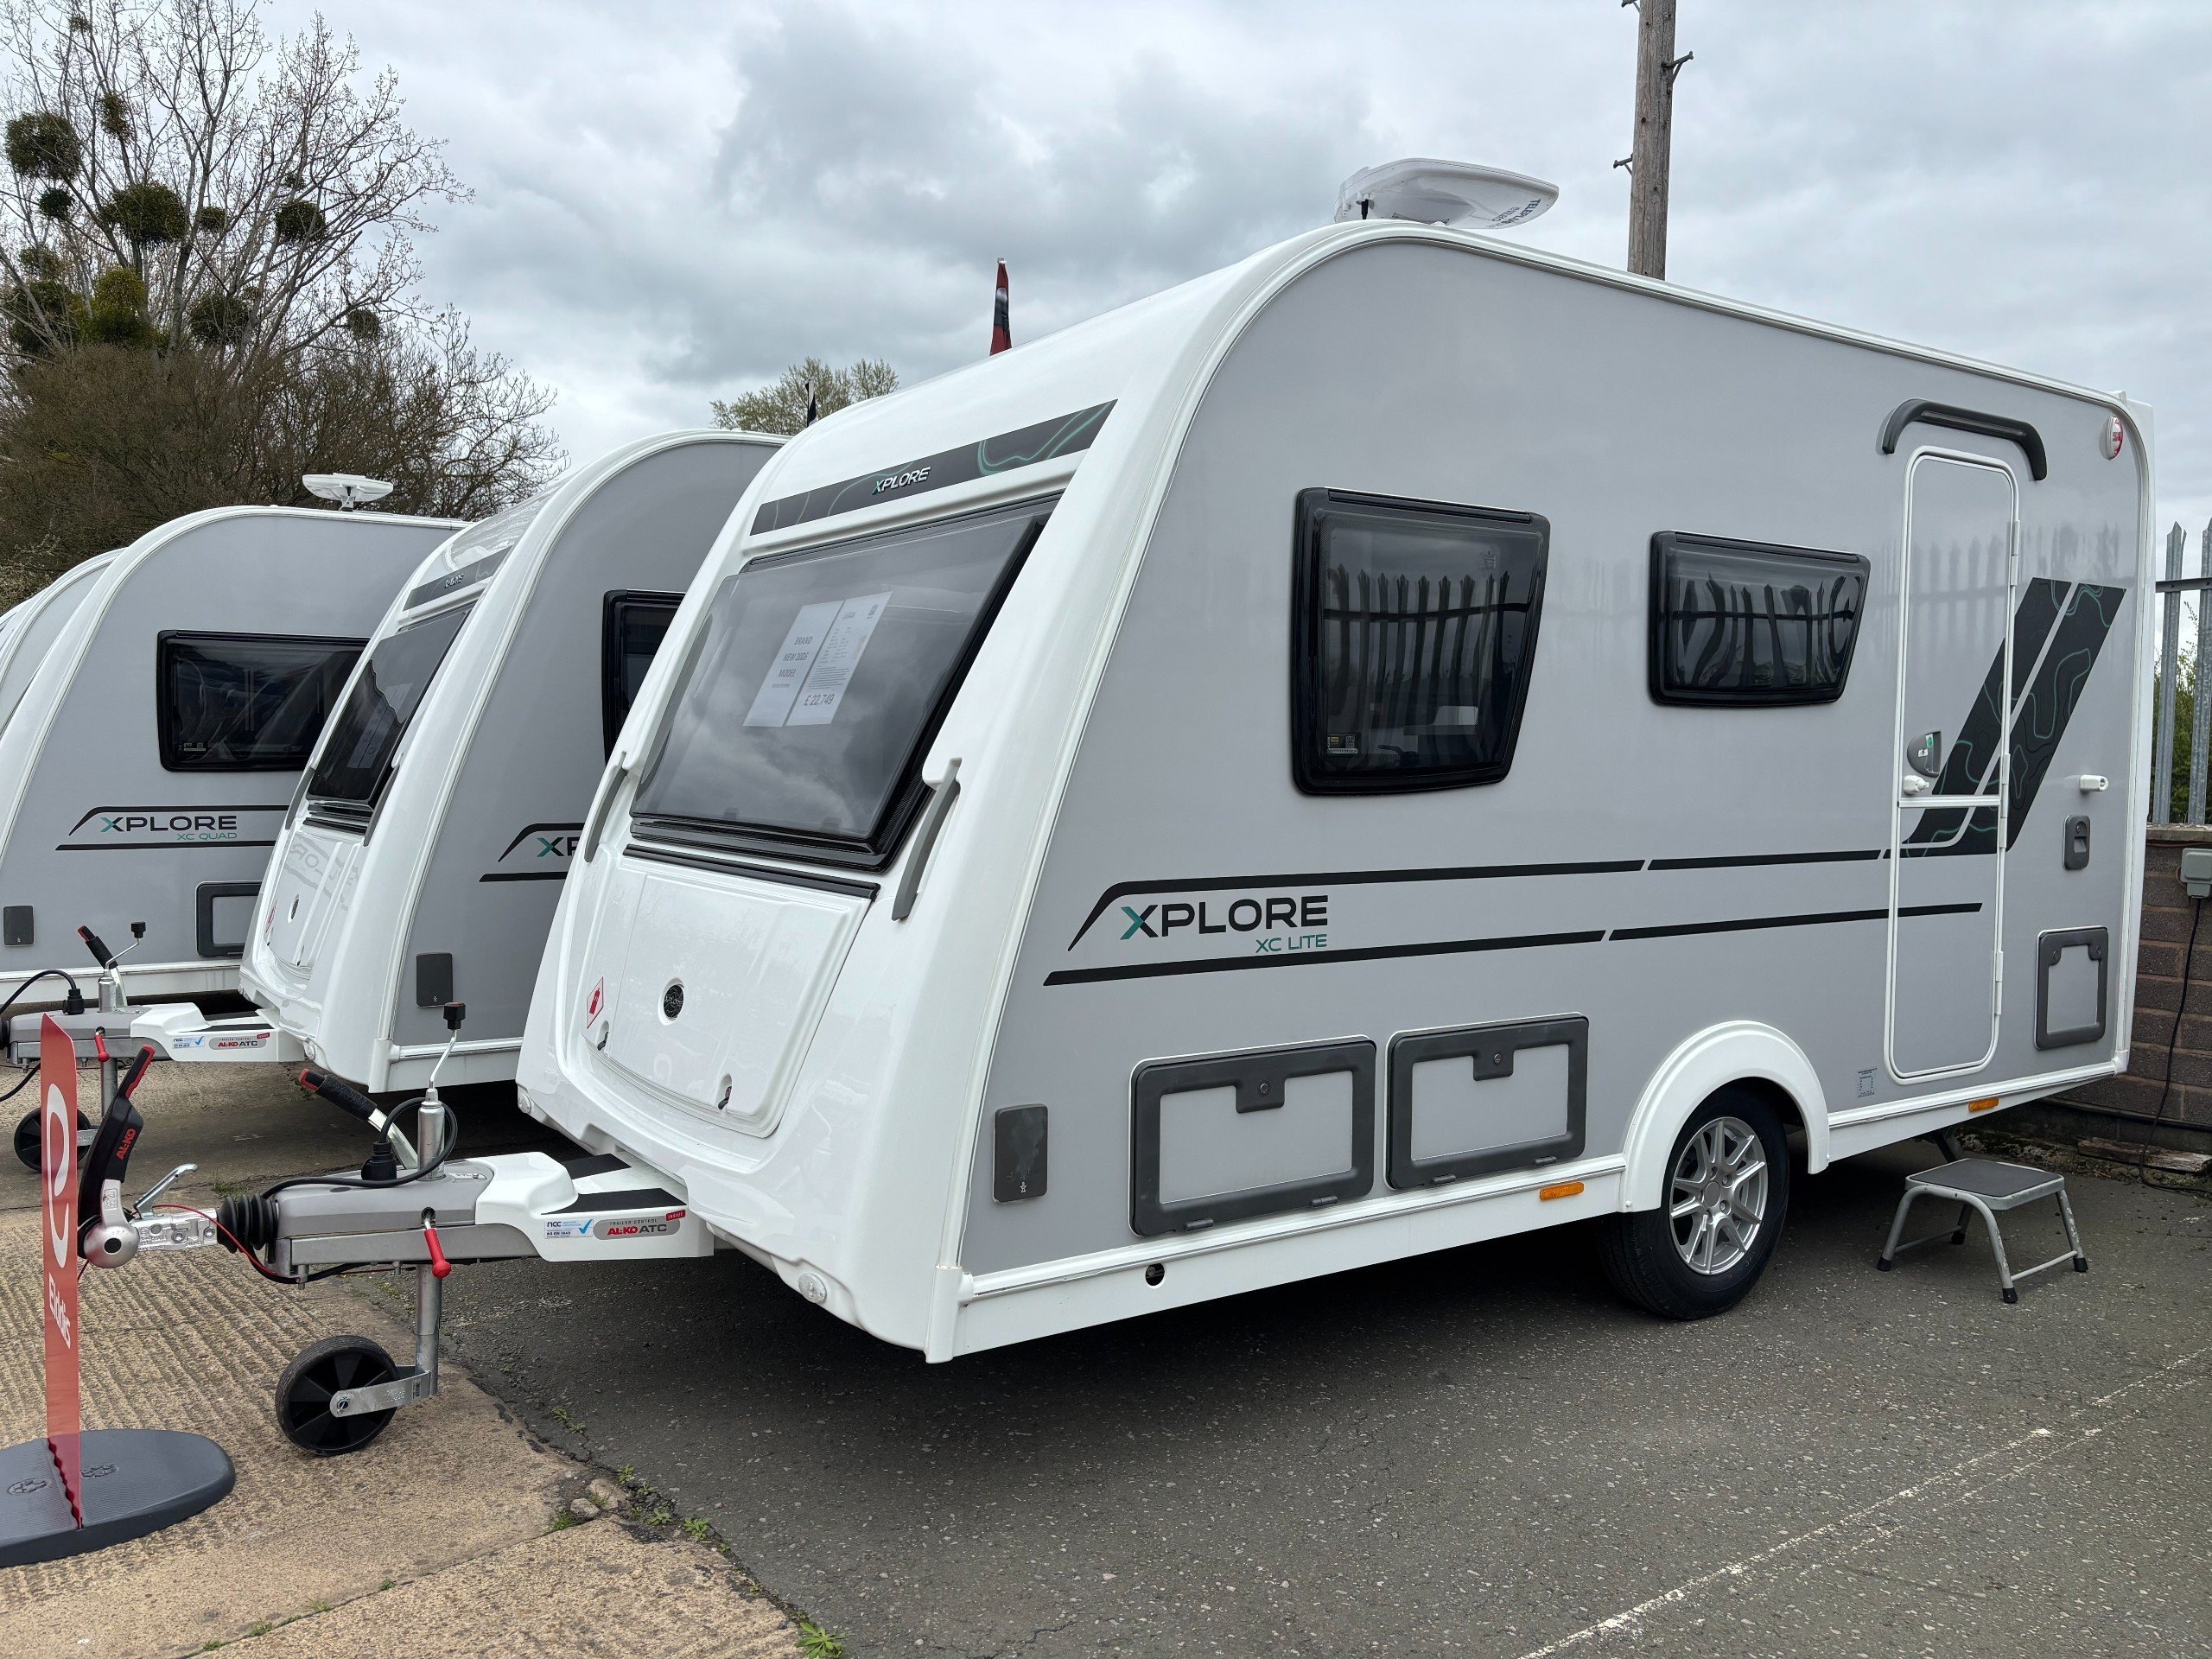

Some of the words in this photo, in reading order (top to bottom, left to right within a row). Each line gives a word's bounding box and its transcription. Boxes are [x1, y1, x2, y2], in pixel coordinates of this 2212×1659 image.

[872, 467, 931, 495] XPLORE
[794, 636, 813, 645] BRAND
[778, 669, 796, 677] MODEL
[100, 815, 238, 833] XPLORE
[199, 832, 238, 841] QUAD
[1120, 895, 1328, 940] XPLORE
[1255, 938, 1282, 953] XC
[1288, 934, 1327, 950] LITE
[639, 1224, 667, 1234] ATC
[48, 1271, 71, 1350] Elddis
